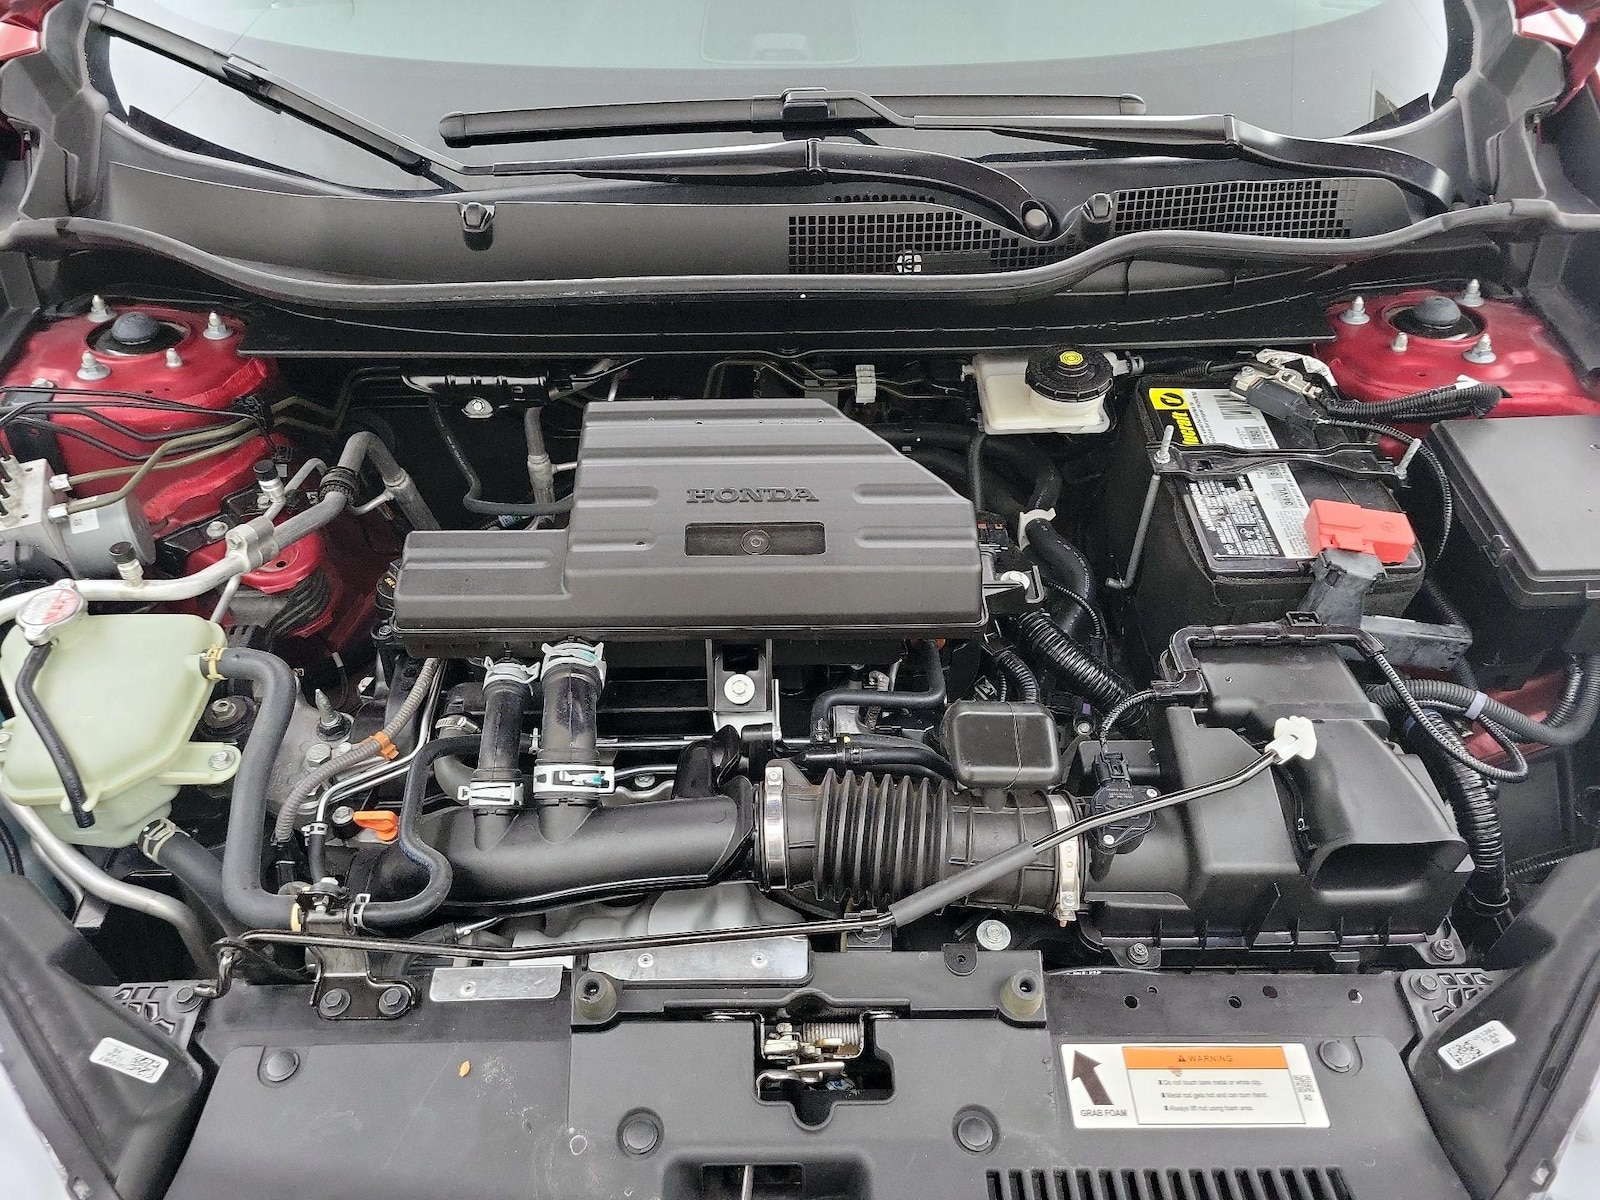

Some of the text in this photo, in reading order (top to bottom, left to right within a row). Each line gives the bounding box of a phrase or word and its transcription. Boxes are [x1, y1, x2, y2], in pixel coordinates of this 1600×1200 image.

[1171, 411, 1201, 445] lucraft
[686, 487, 820, 503] HONDA
[1189, 1054, 1233, 1063] WARNING
[1080, 1108, 1127, 1117] GRAB FOAM
